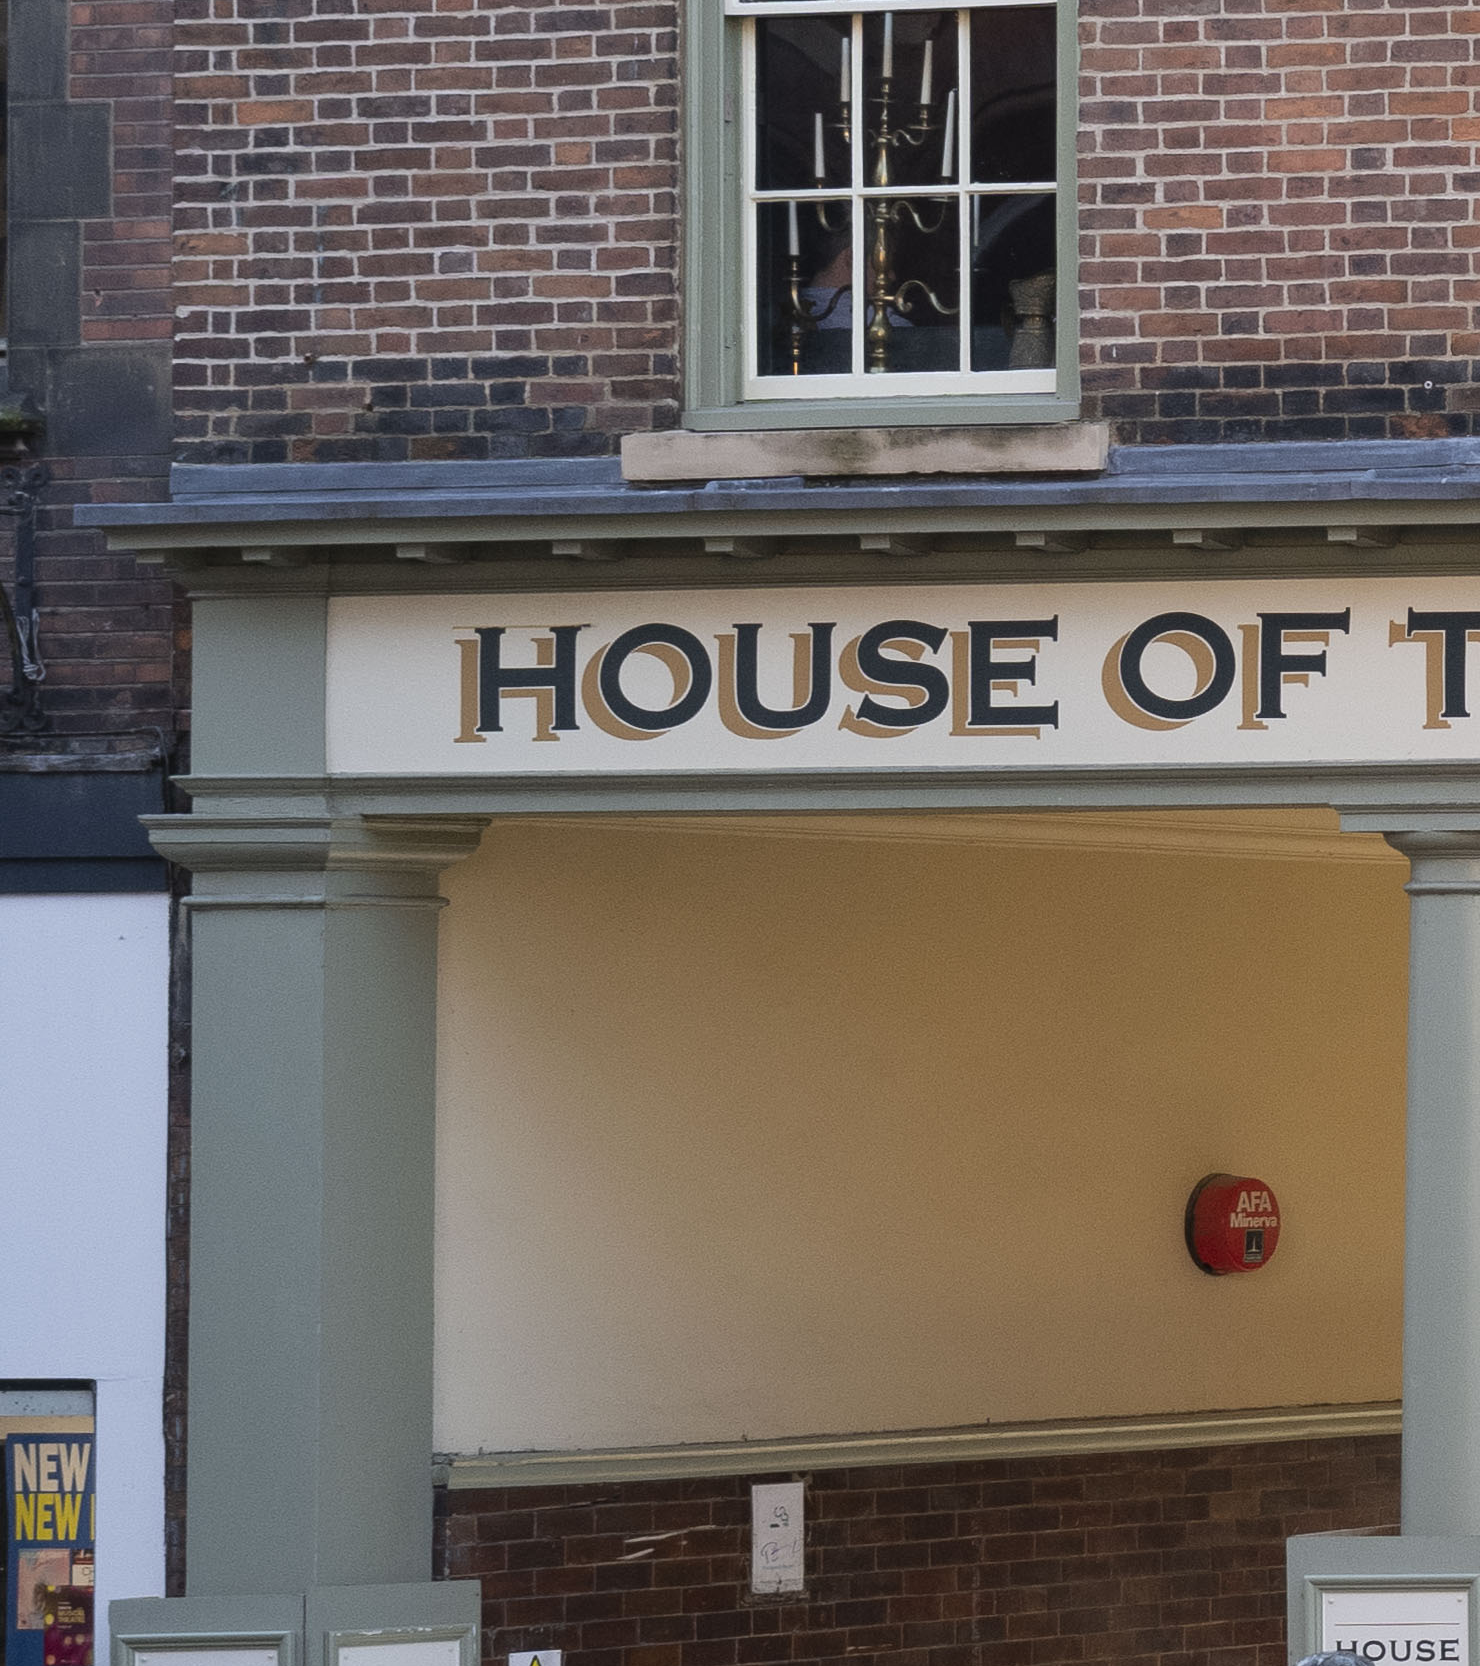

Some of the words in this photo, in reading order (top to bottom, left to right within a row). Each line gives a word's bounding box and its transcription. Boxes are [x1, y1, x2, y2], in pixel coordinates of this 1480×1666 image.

[453, 613, 1060, 743] HOUSE
[1102, 607, 1352, 732] OF
[1230, 1212, 1278, 1228] Minerva
[1236, 1191, 1272, 1212] AFA
[13, 1443, 91, 1493] NEW
[15, 1493, 82, 1541] NEW
